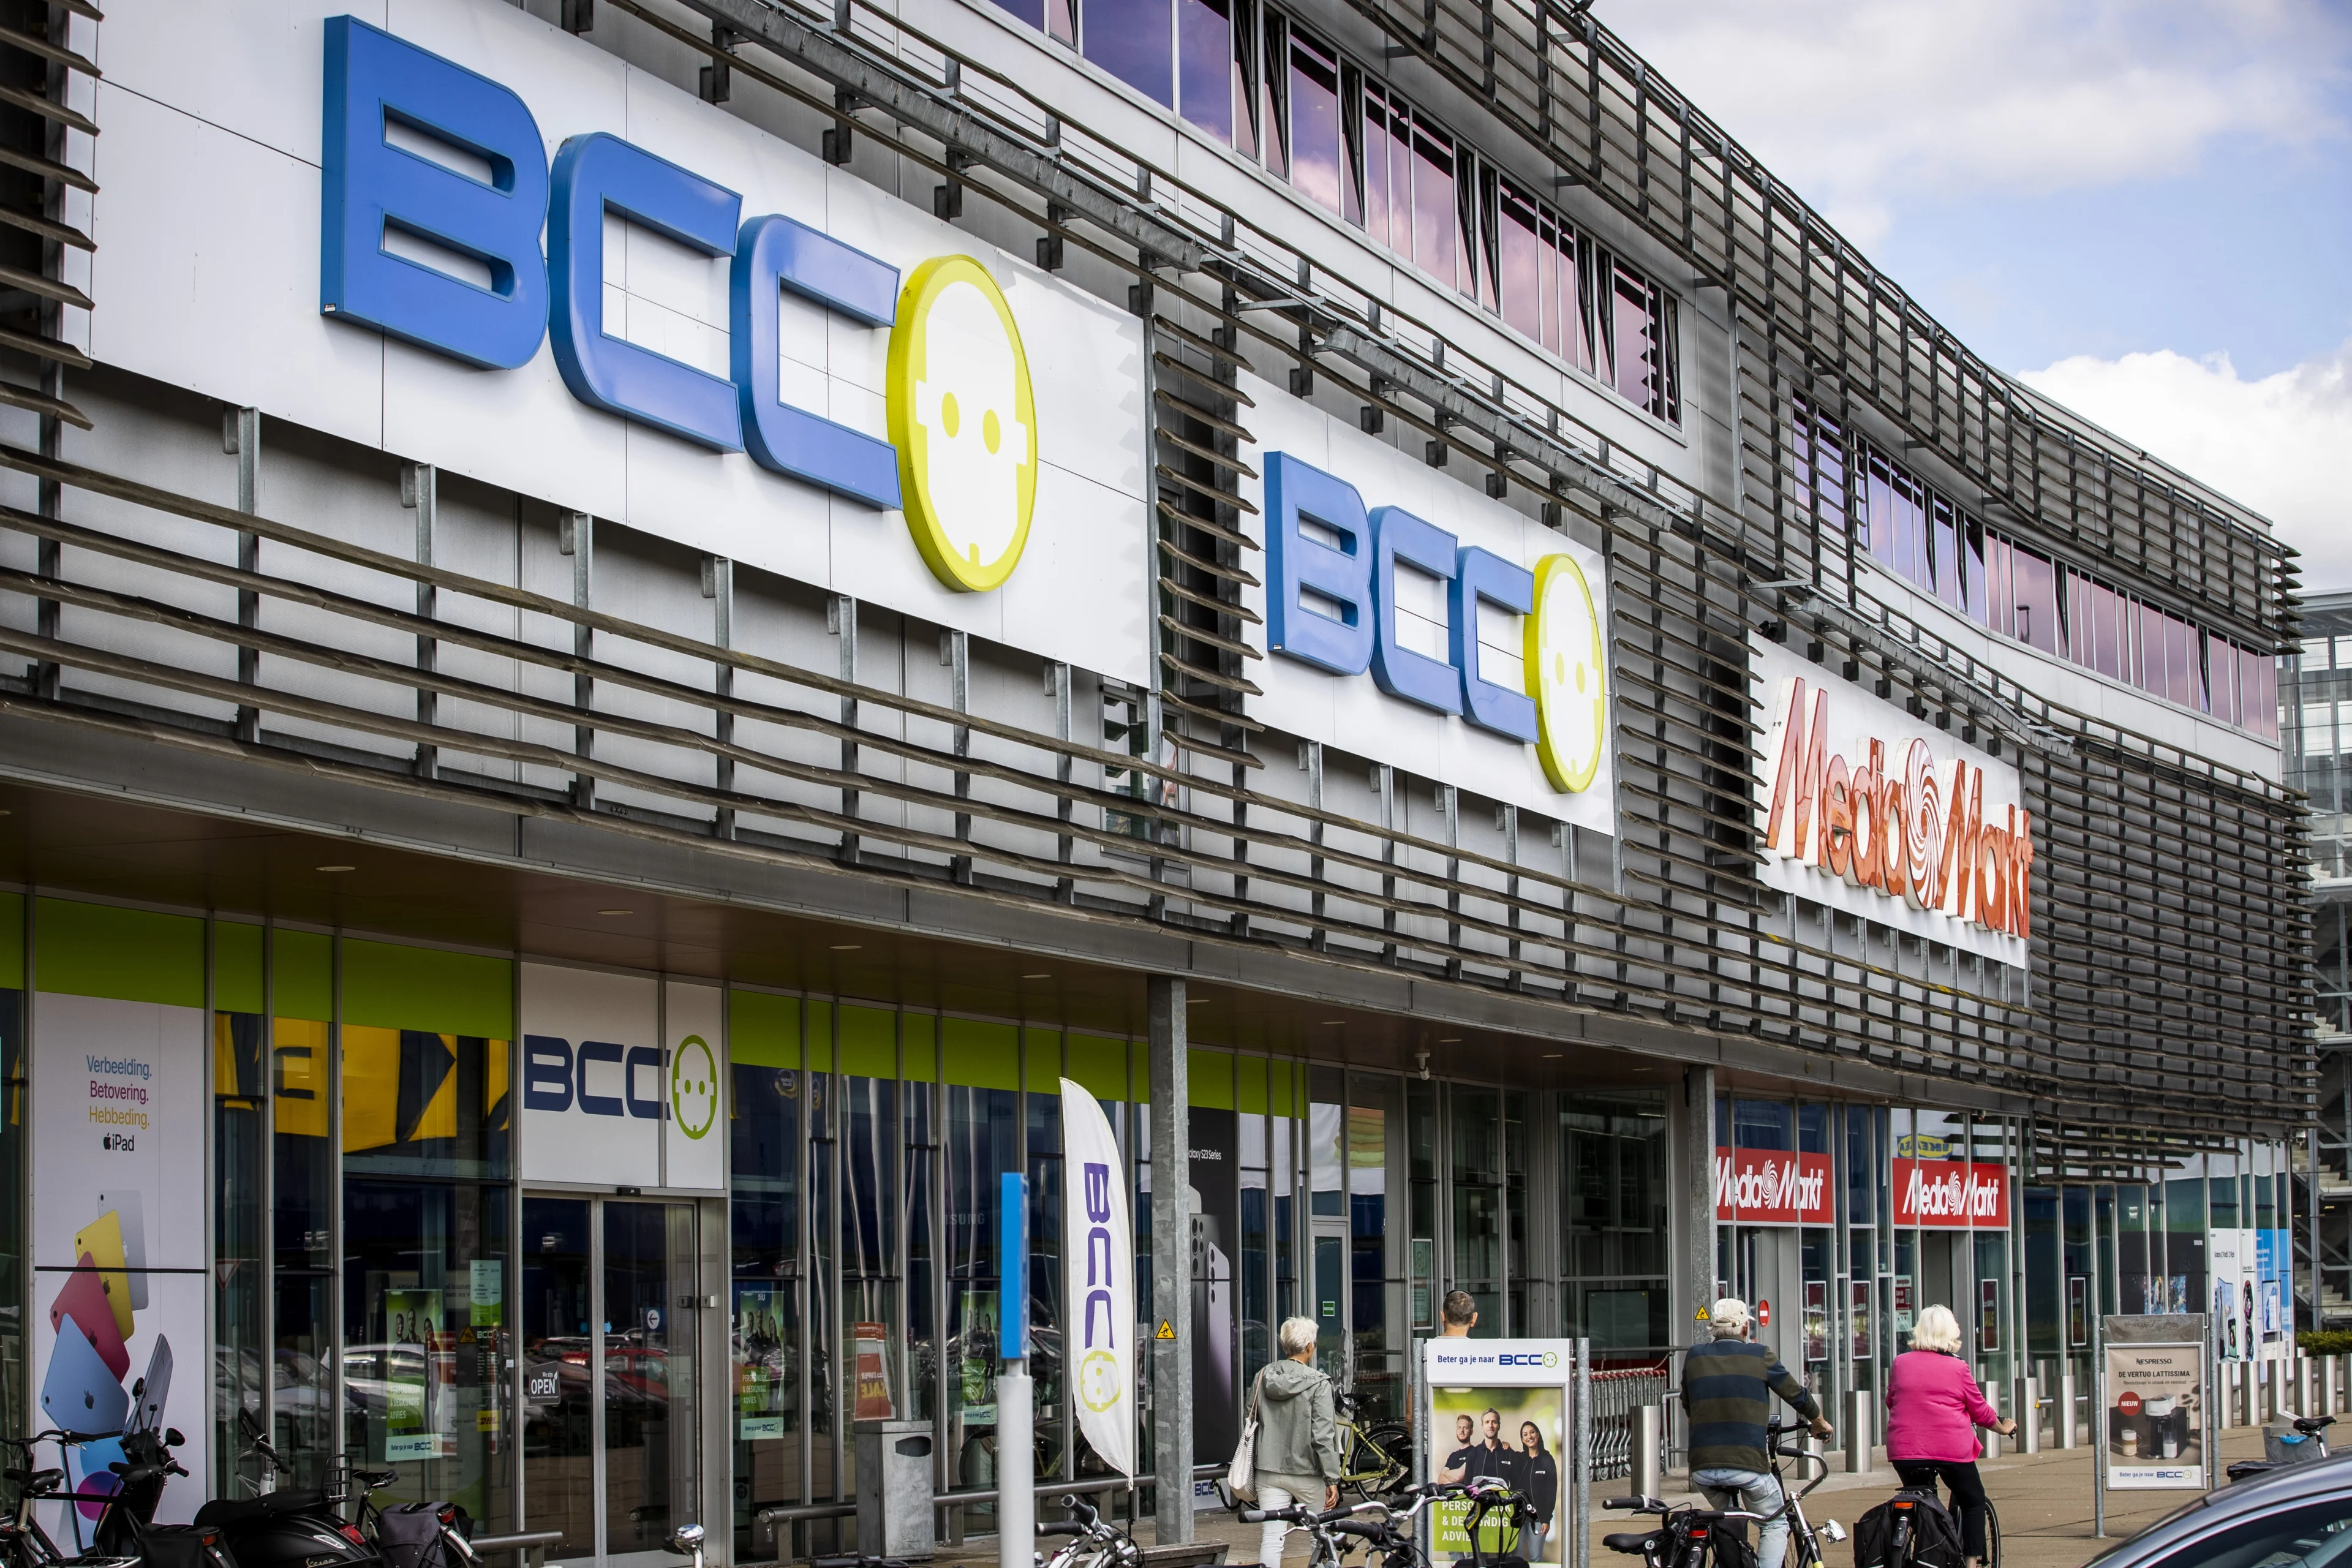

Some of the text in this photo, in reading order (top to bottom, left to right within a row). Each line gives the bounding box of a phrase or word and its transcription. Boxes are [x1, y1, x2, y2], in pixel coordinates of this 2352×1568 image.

[86, 1055, 152, 1080] Verbeelding.
[90, 1080, 149, 1105] Betovering.
[89, 1106, 150, 1129] Hebbeding.
[112, 1134, 135, 1152] iPad
[1188, 1148, 1200, 1161] alaxy
[1208, 1150, 1221, 1160] Series
[1469, 1355, 1477, 1365] je
[1499, 1354, 1542, 1365] BCC
[531, 1379, 556, 1395] OPEN
[394, 1397, 420, 1406] DESKUNDIG
[390, 1411, 407, 1419] ADVIES
[1442, 1516, 1449, 1526] &
[1442, 1531, 1471, 1542] ADVIE
